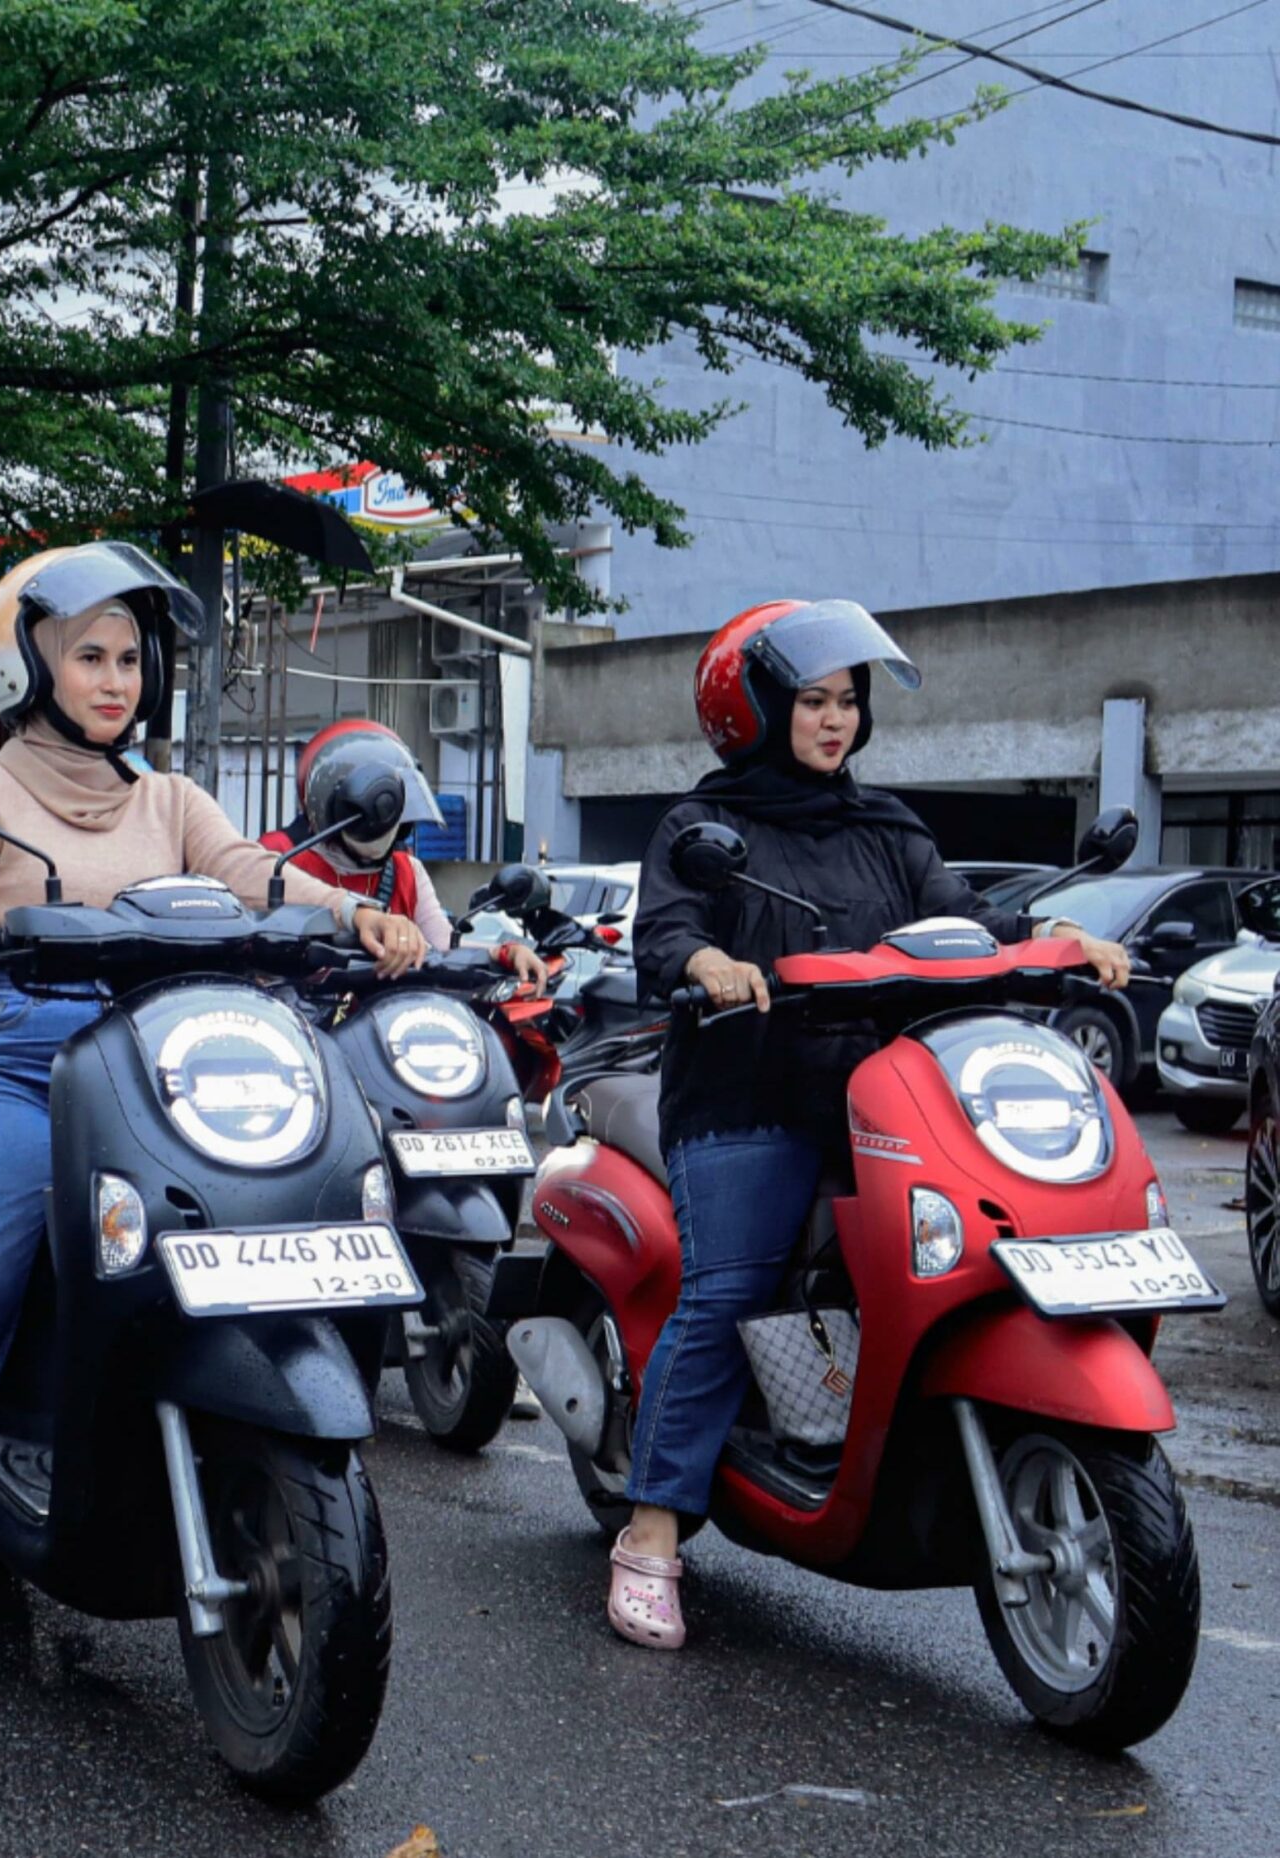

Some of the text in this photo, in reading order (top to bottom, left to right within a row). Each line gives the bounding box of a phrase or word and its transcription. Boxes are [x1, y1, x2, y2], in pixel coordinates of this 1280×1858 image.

[399, 1137, 424, 1152] DD
[486, 1133, 525, 1150] XCE
[174, 1233, 393, 1270] DD 4446 XDL
[1008, 1235, 1185, 1273] DD 5543 YU
